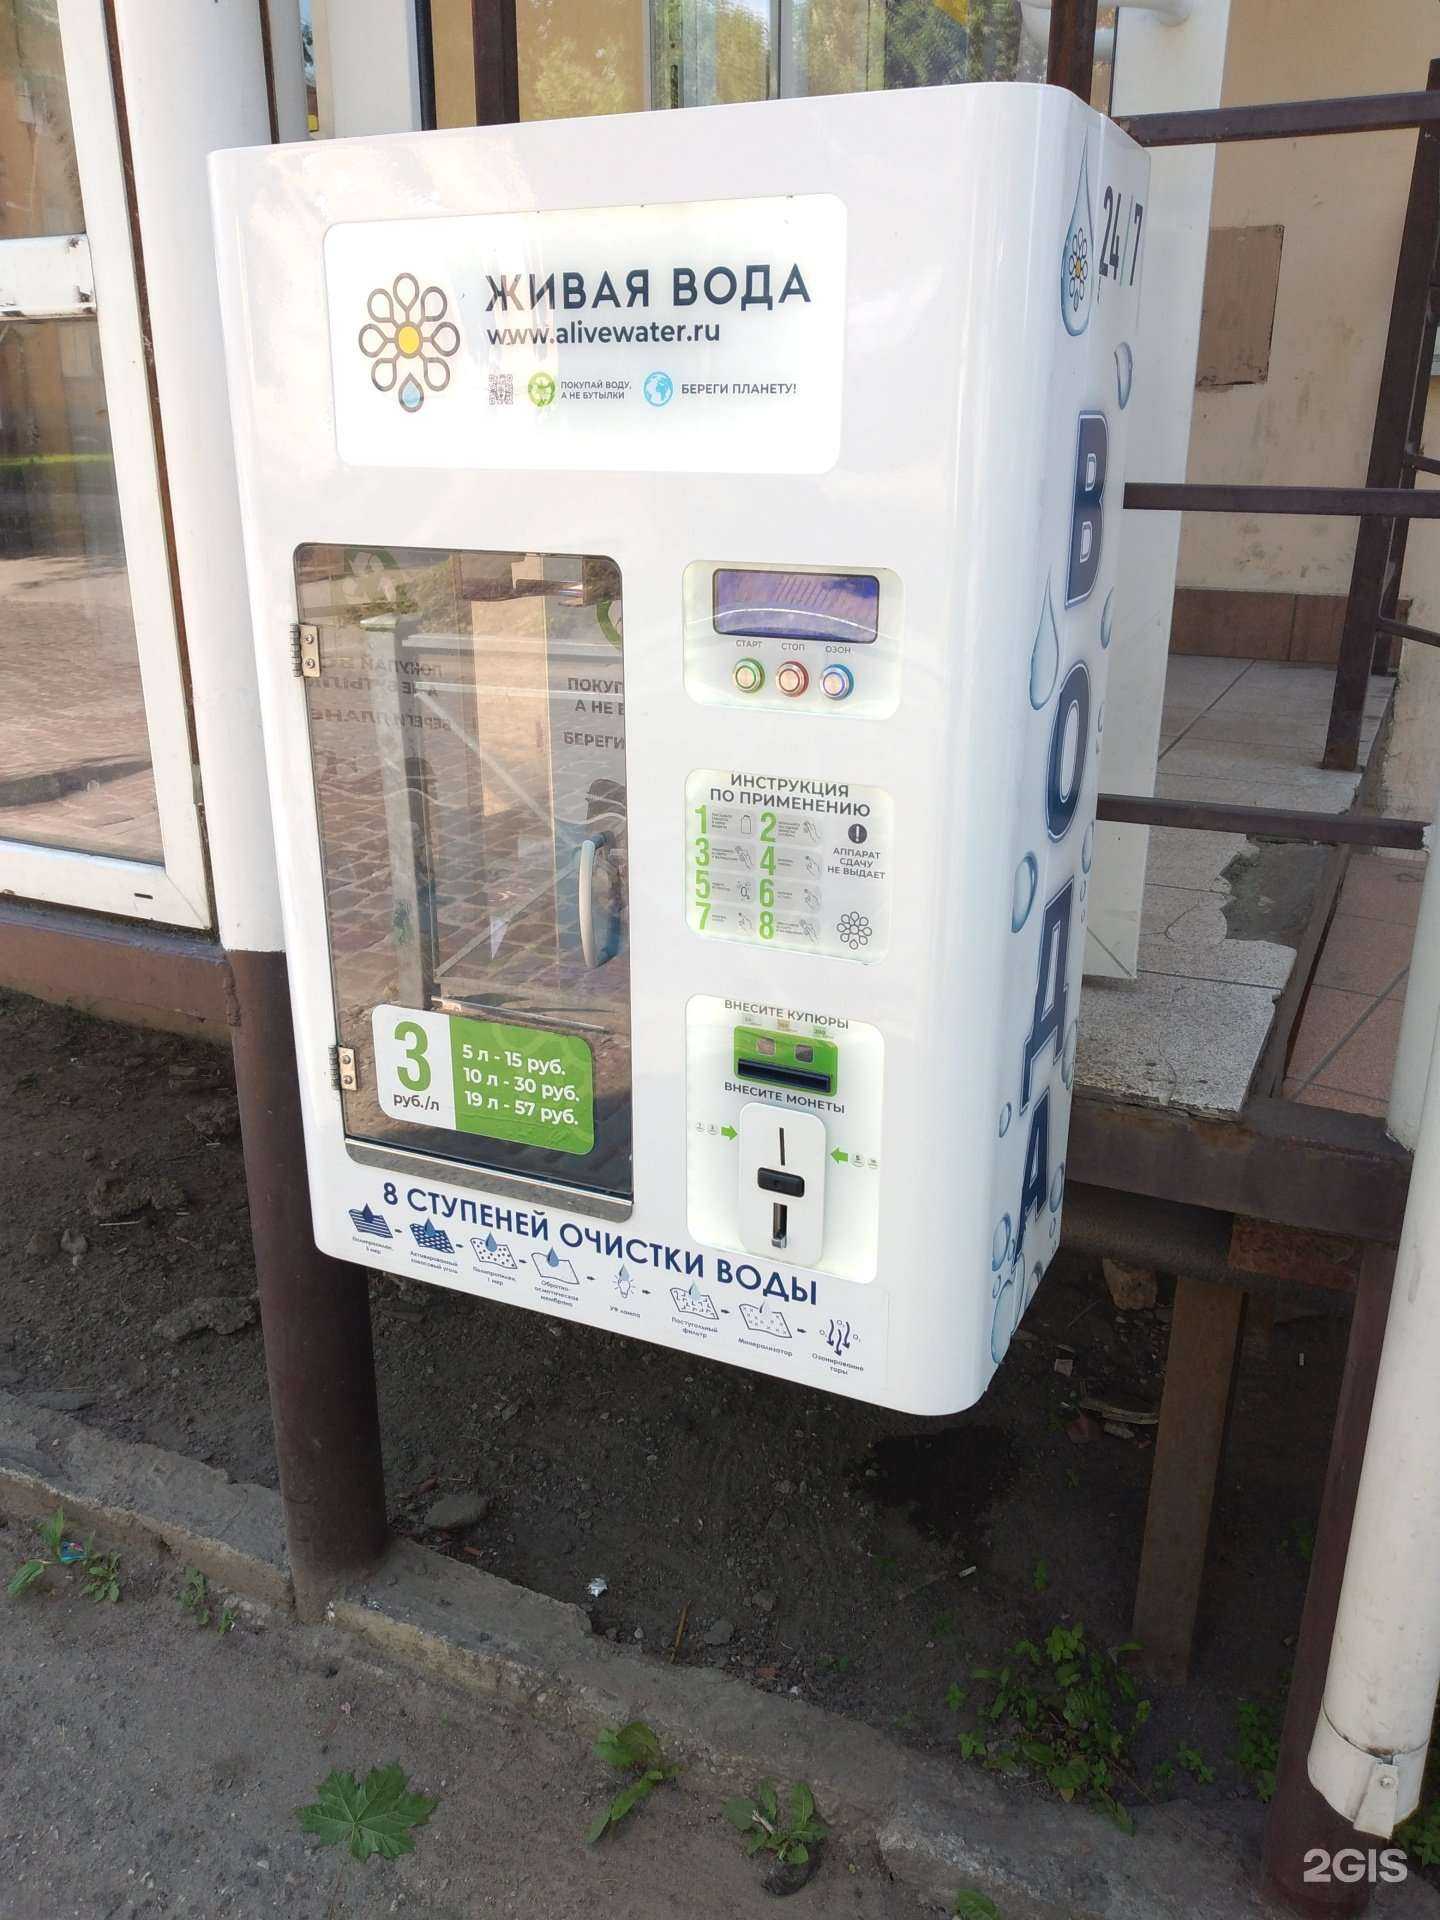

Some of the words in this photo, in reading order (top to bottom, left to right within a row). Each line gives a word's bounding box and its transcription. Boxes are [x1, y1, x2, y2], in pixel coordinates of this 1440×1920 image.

[485, 269, 649, 312] ЖИВАЯ
[673, 263, 811, 311] ВОДА
[487, 320, 720, 346] www.alivewater.ru
[561, 379, 603, 390] ПОКУПАЙ
[605, 380, 632, 391] ВОДУ,
[561, 392, 568, 400] А
[569, 391, 582, 400] НЕ
[583, 391, 625, 400] БУТЫЛКИ
[681, 383, 728, 395] БЕРЕГИ
[732, 383, 797, 395] ПЛАНЕТУ!
[736, 639, 762, 648] СТАРТ
[781, 642, 805, 652] СТОП
[825, 645, 851, 654] ОЗОН
[575, 699, 586, 712] А
[592, 701, 613, 714] НЕ
[731, 774, 849, 798] ИНСТРУКЦИЯ
[711, 788, 734, 803] ПО
[740, 791, 870, 817] ПРИМЕНЕНИЮ
[695, 804, 707, 834] 1
[760, 812, 777, 843] 2
[695, 837, 710, 866] 3
[760, 846, 776, 875] 4
[833, 847, 880, 860] АППАРАТ
[840, 858, 873, 868] СДАЧУ
[695, 869, 710, 899] 5
[827, 866, 847, 875] НЕ
[848, 868, 885, 880] ВЫДАЕТ
[760, 878, 775, 908] 6
[695, 901, 711, 930] 7
[759, 911, 774, 940] 8
[724, 1000, 784, 1018] ВНЕСИТЕ
[787, 1010, 849, 1029] КУПЮРЫ
[393, 1021, 431, 1091] 3
[462, 1044, 473, 1059] 5
[478, 1050, 489, 1062] л
[504, 1052, 522, 1068] 15
[528, 1058, 566, 1076] руб.
[464, 1068, 482, 1084] 10
[486, 1074, 498, 1087] л
[514, 1076, 536, 1093] 30
[542, 1083, 580, 1102] руб.
[724, 1081, 783, 1101] ВНЕСИТЕ
[786, 1094, 845, 1114] МОНЕТЫ
[393, 1093, 439, 1111] руб./л
[465, 1091, 482, 1107] 19
[487, 1098, 498, 1110] л
[514, 1100, 535, 1116] 57
[541, 1107, 579, 1125] руб.
[384, 1182, 398, 1205] 8
[407, 1188, 548, 1241] СТУПЕНЕЙ
[560, 1223, 704, 1278] ОЧИСТКИ
[717, 1258, 816, 1305] ВОДЫ
